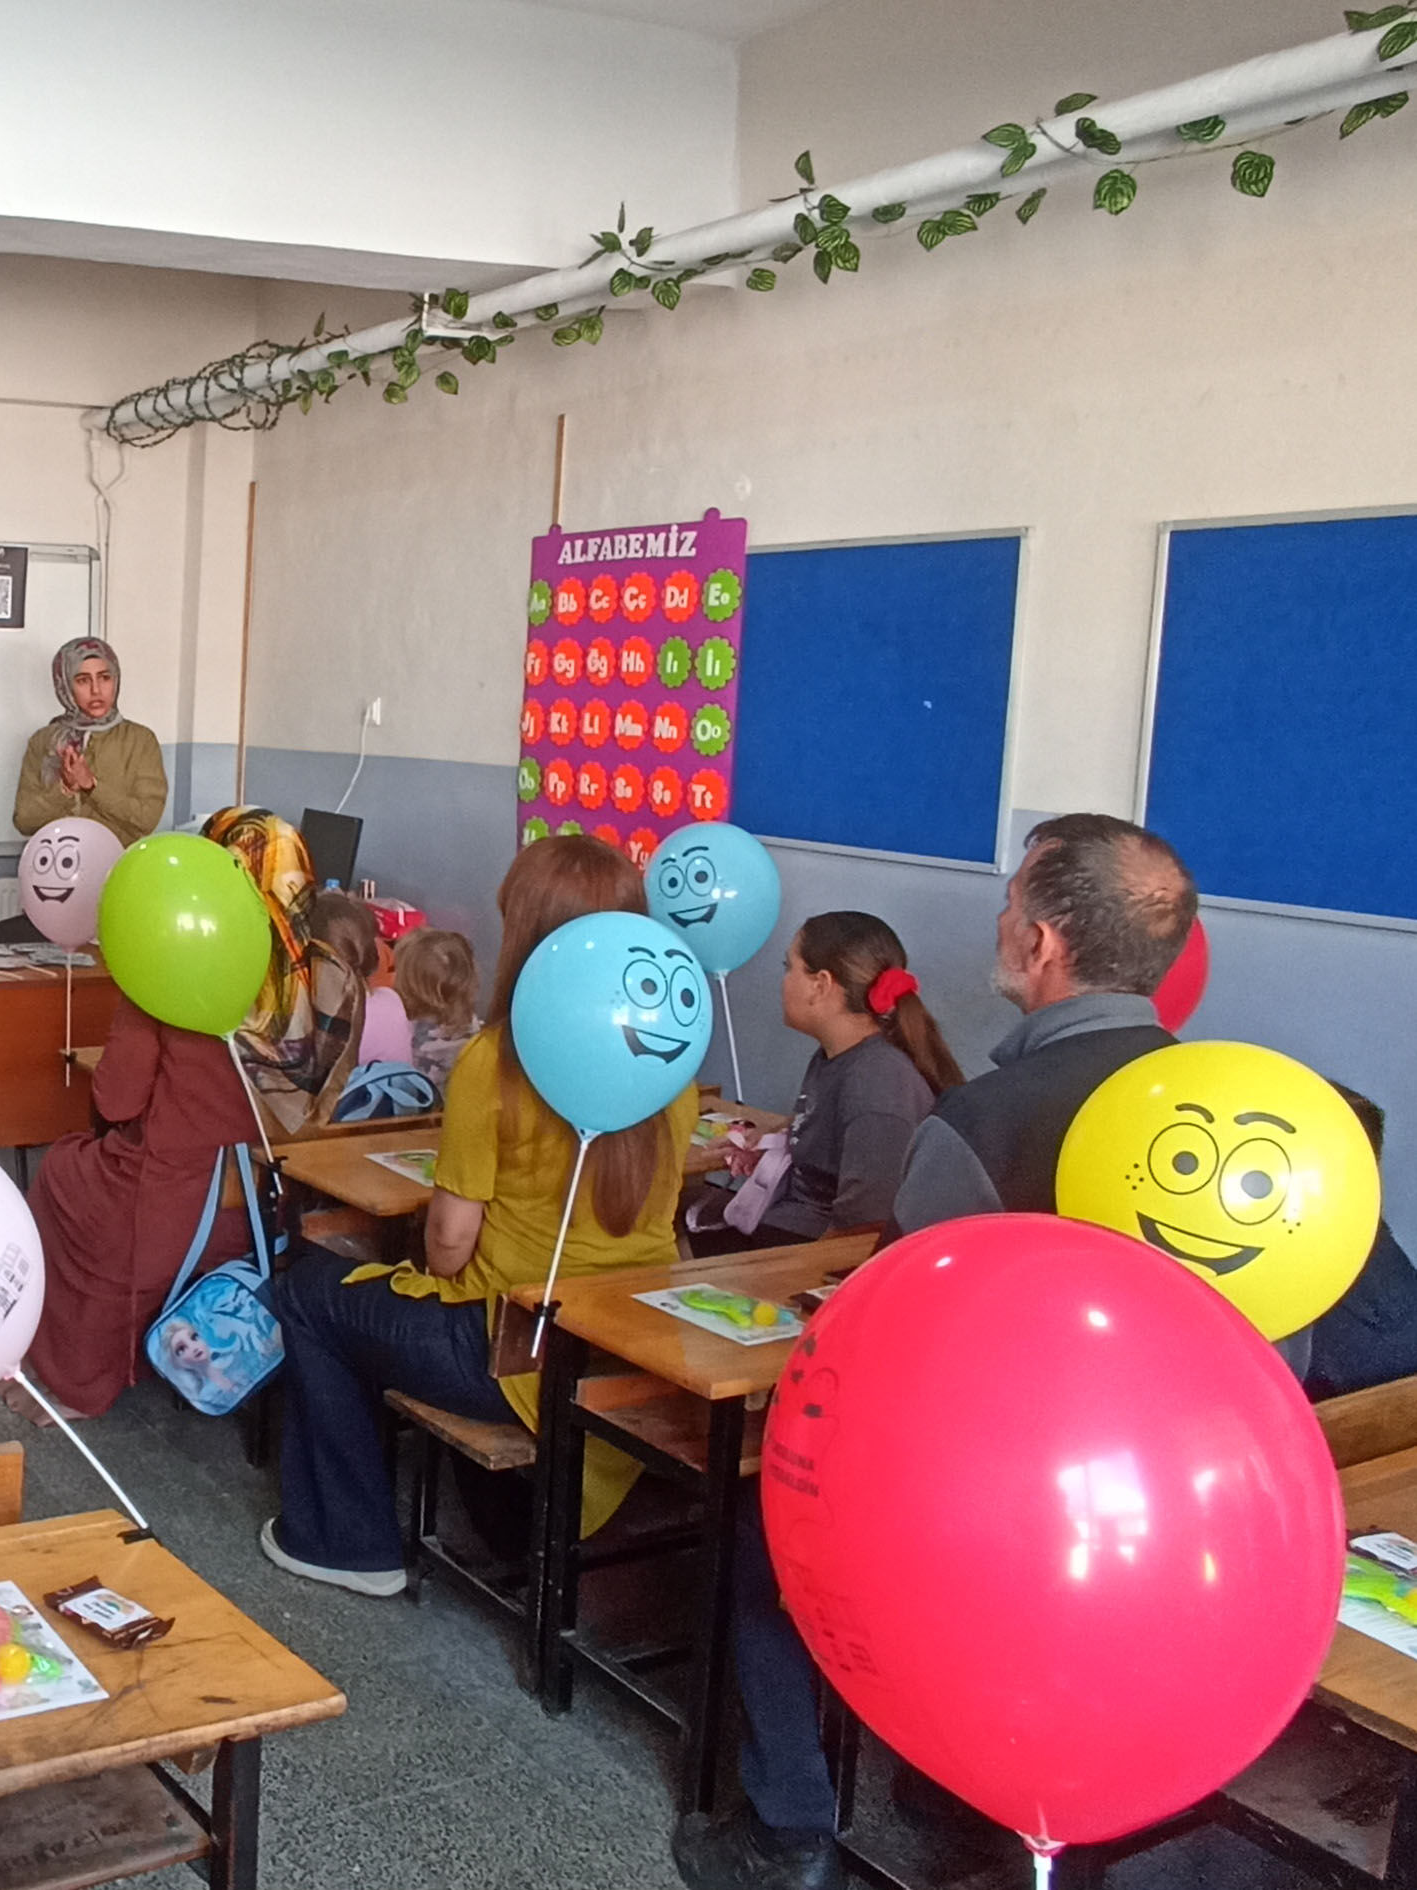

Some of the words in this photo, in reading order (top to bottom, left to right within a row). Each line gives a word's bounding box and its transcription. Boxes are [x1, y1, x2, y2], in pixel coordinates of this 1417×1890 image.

[558, 524, 697, 564] ALFABEMİZ
[558, 592, 578, 613] Bb
[589, 589, 611, 610] Cc
[665, 586, 689, 608] Dd
[526, 652, 541, 676] Ff
[553, 652, 575, 679] Gg
[621, 650, 645, 672] Hh
[583, 712, 600, 734] Ll
[614, 713, 643, 736] Mm
[654, 716, 677, 739] Nn
[696, 719, 721, 741] Oo
[549, 772, 566, 799] Pp
[579, 773, 599, 796] Rr
[692, 784, 713, 808] Tt
